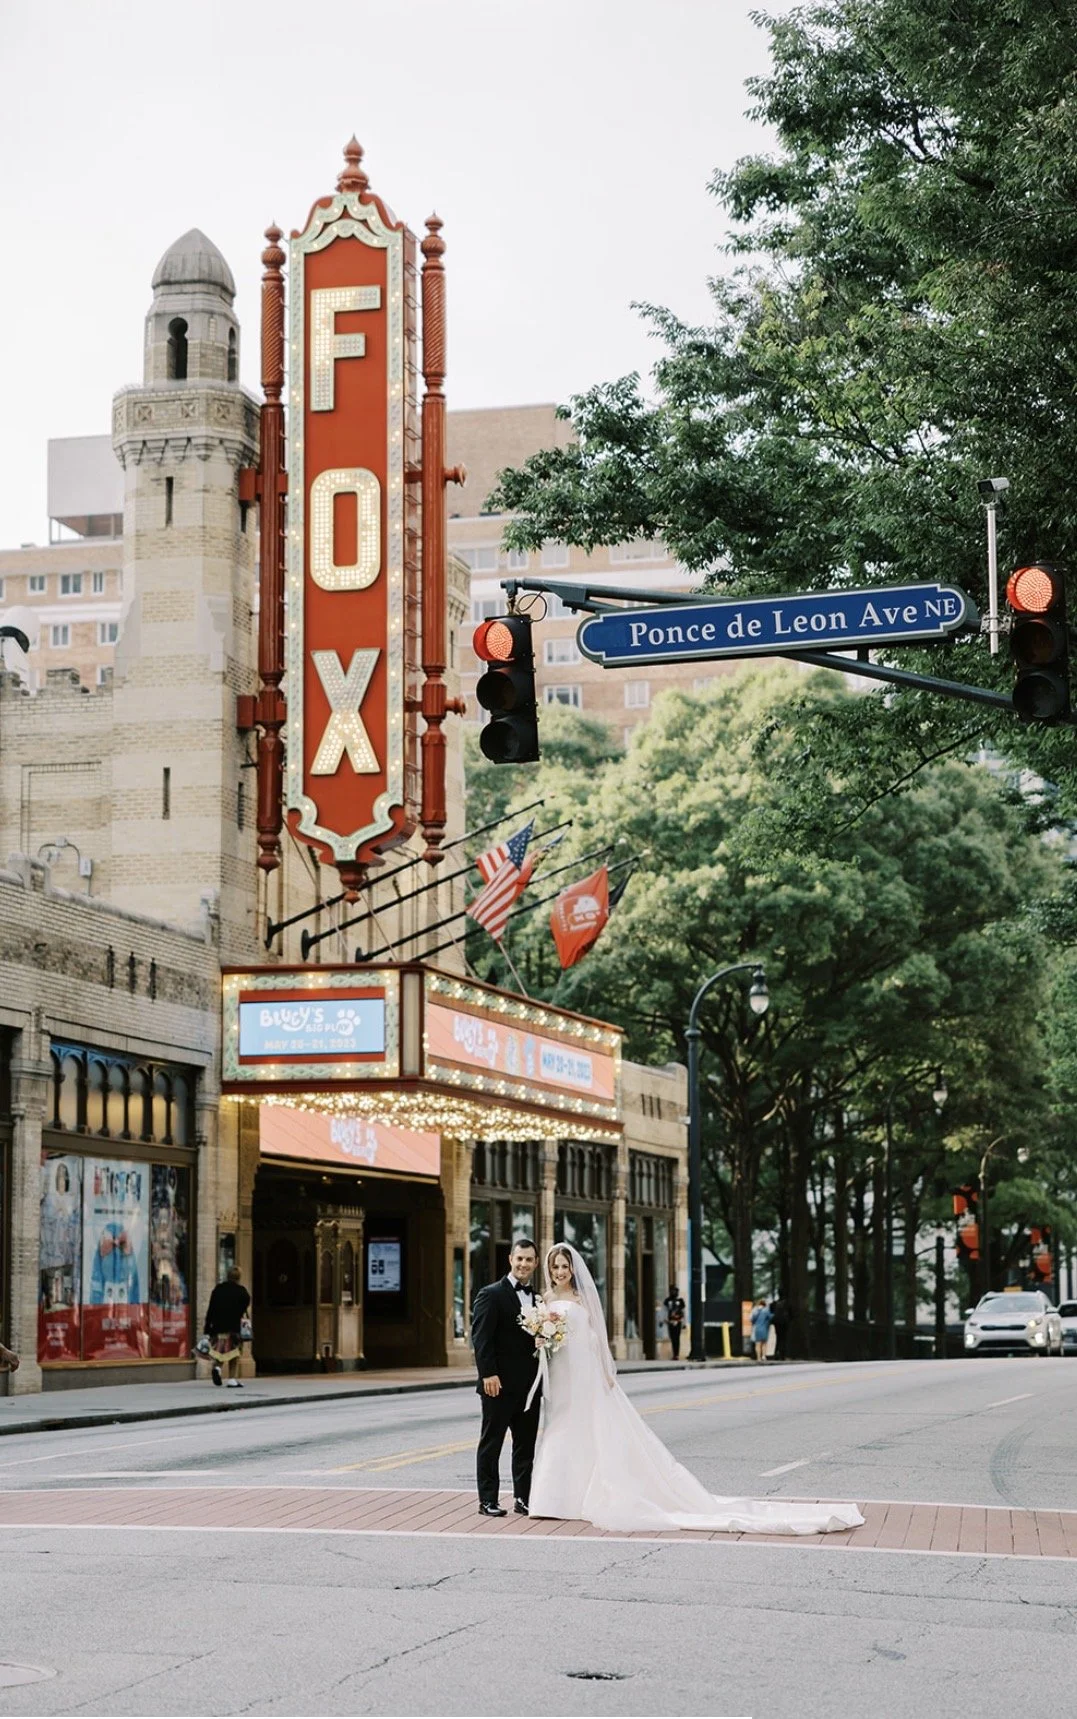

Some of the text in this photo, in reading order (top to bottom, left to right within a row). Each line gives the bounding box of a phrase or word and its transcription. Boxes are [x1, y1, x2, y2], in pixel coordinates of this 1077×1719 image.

[310, 284, 381, 776] FOX
[629, 597, 957, 648] Ponce de Leon Ave NE
